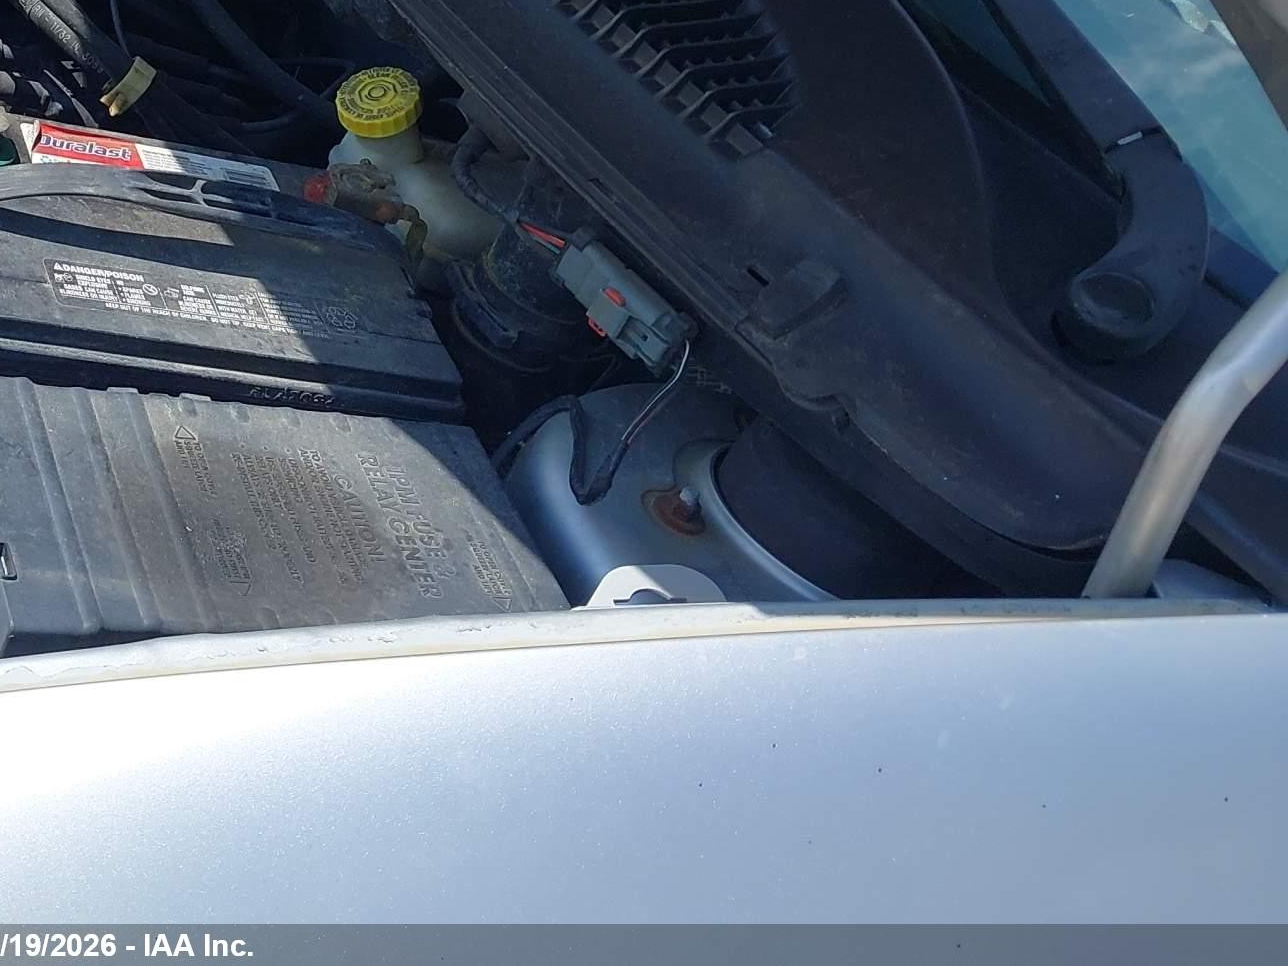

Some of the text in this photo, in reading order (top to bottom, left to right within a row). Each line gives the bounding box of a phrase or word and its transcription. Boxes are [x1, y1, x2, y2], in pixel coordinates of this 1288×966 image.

[39, 132, 132, 161] Duralast
[62, 263, 144, 282] DANGER/POISON
[356, 450, 444, 598] RELAY CENTER
